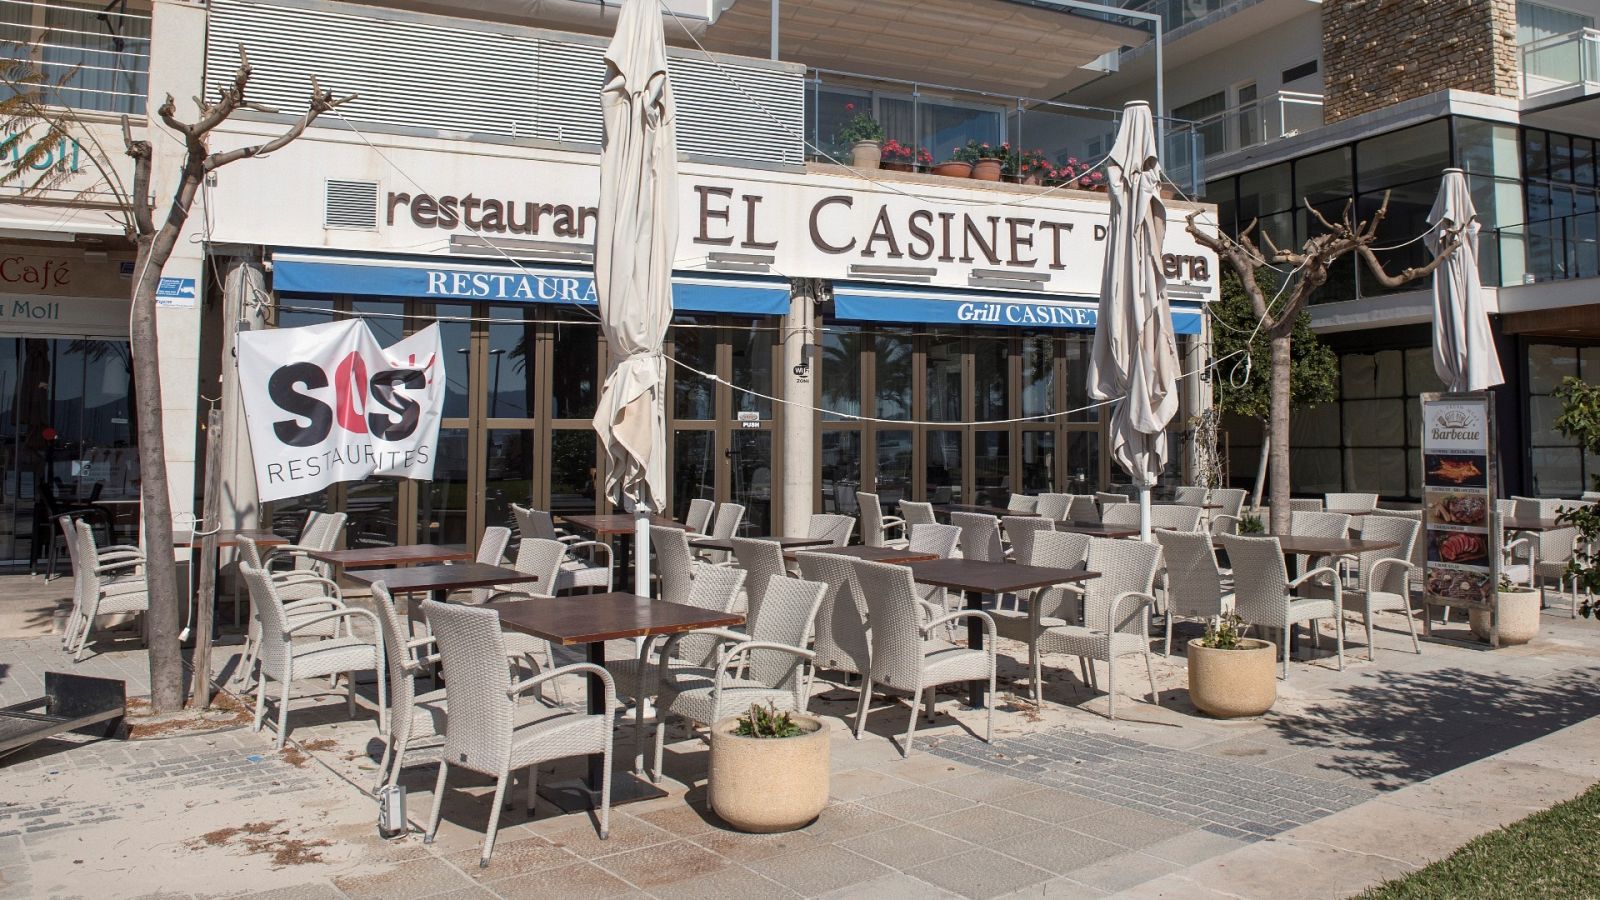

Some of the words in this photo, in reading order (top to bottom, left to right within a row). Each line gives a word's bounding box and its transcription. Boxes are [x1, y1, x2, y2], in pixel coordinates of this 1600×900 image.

[386, 191, 599, 239] restauran
[693, 184, 778, 251] EL
[809, 195, 1074, 271] CASINET
[0, 257, 71, 290] Café
[426, 271, 599, 302] RESTAURA
[12, 301, 59, 320] Moll
[957, 302, 1001, 323] Grill
[268, 351, 426, 448] SOS
[1431, 427, 1480, 441] Barbecue
